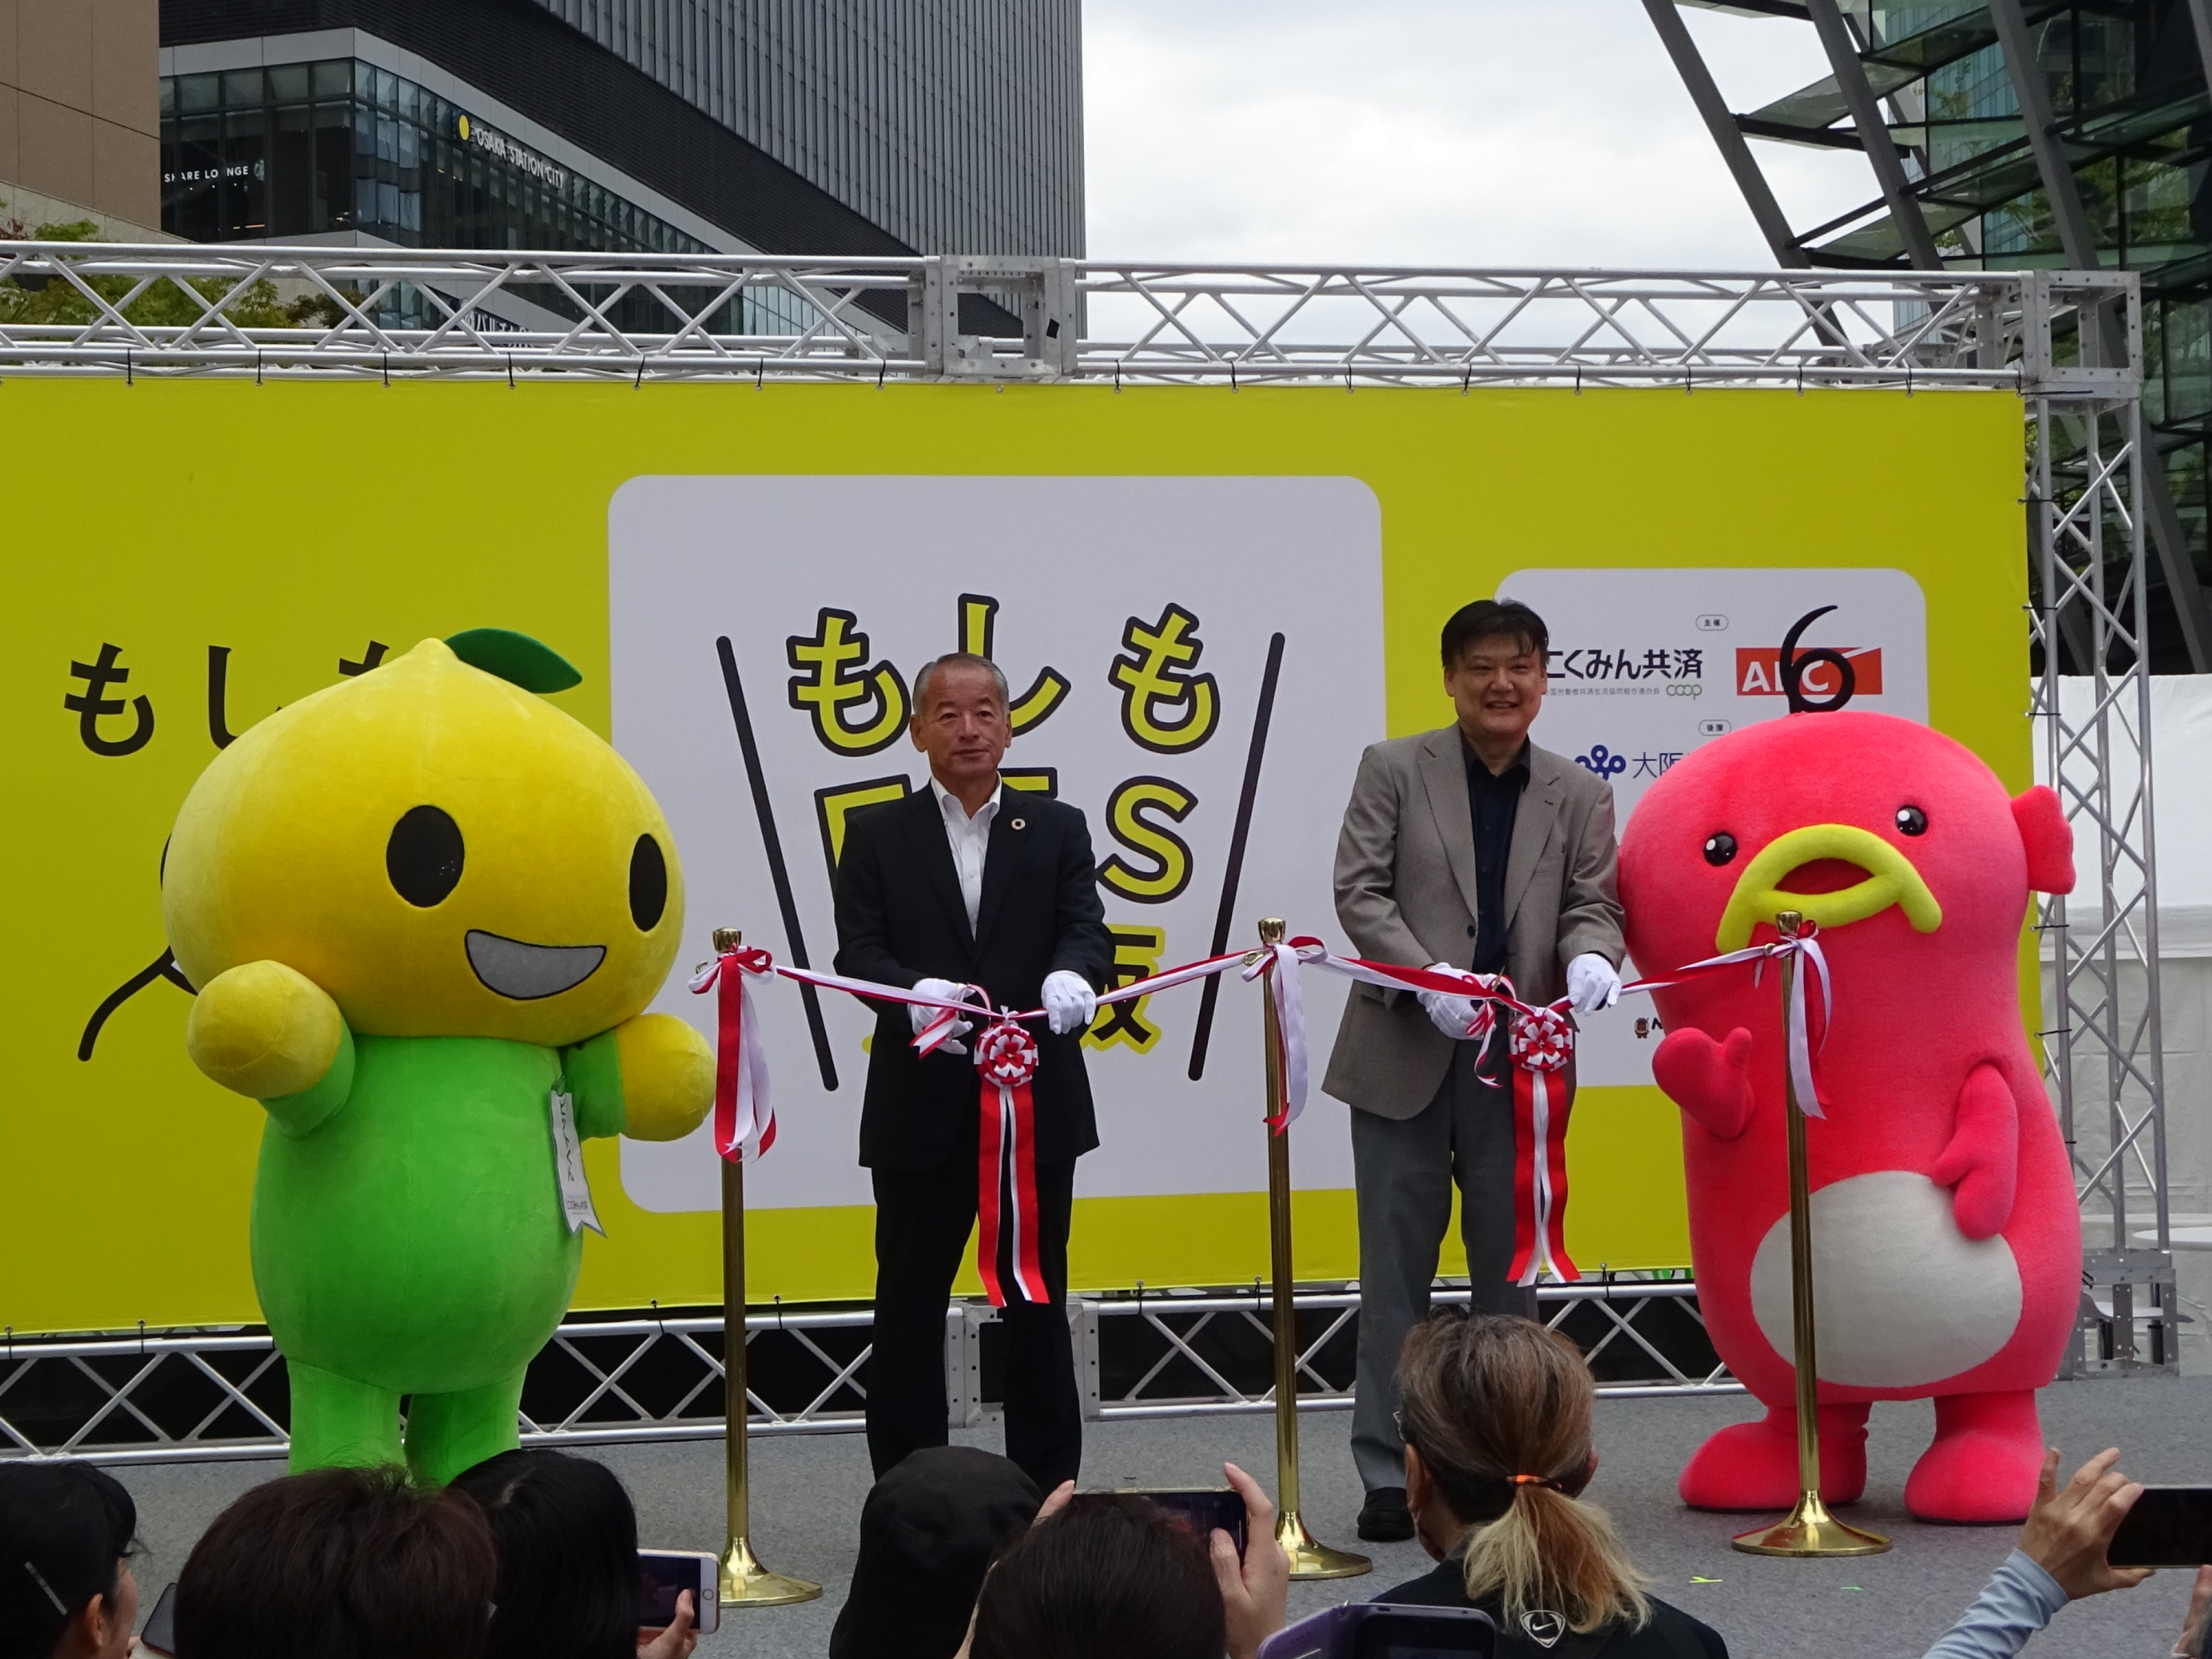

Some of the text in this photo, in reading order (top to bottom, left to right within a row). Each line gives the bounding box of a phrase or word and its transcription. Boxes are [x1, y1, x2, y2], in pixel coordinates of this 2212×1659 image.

[205, 165, 249, 179] LONGE
[476, 128, 564, 189] OSAKA STATION CITY
[64, 641, 390, 757] もし
[1632, 752, 1690, 779] 大阪
